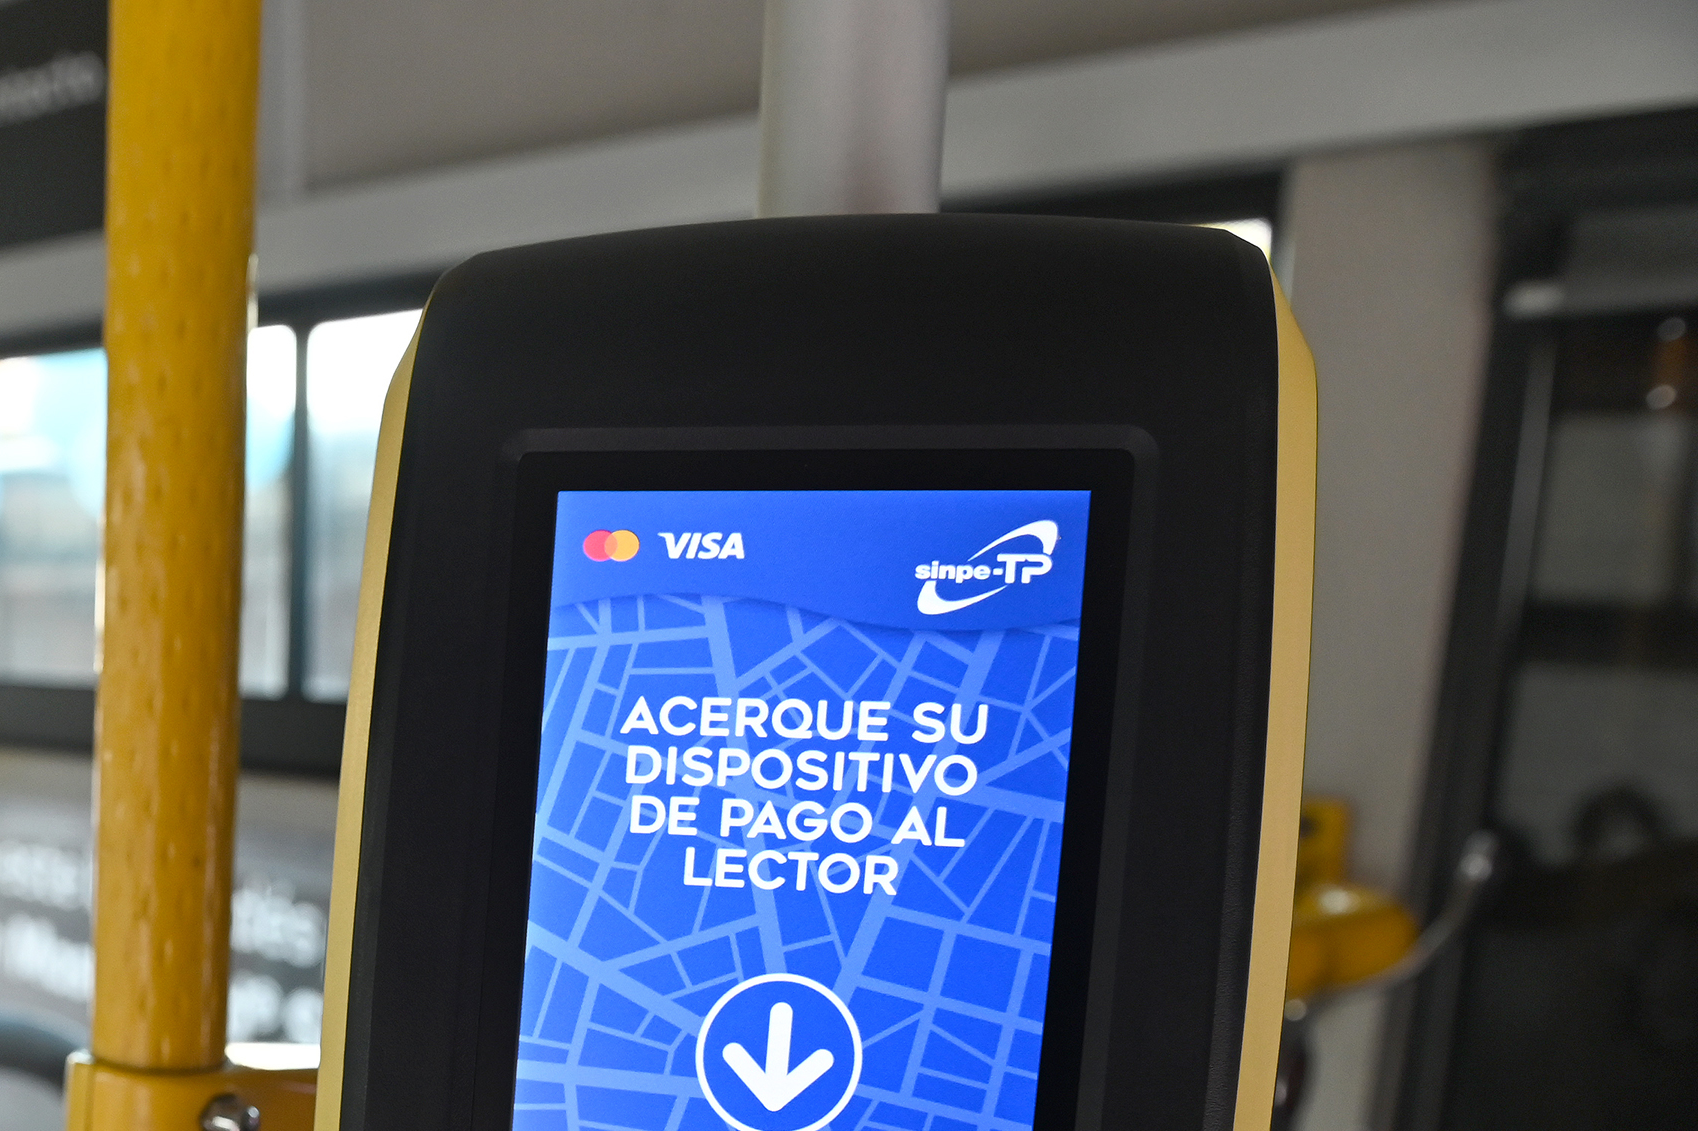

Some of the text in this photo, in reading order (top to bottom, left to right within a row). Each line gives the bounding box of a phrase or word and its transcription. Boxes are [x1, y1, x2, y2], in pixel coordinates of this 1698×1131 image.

[657, 532, 745, 559] VISA
[620, 696, 988, 745] ACERQUE SU
[625, 745, 978, 796] DISPOSITIVO
[629, 795, 966, 848] DE PAGO AL
[683, 847, 899, 896] LECTOR
